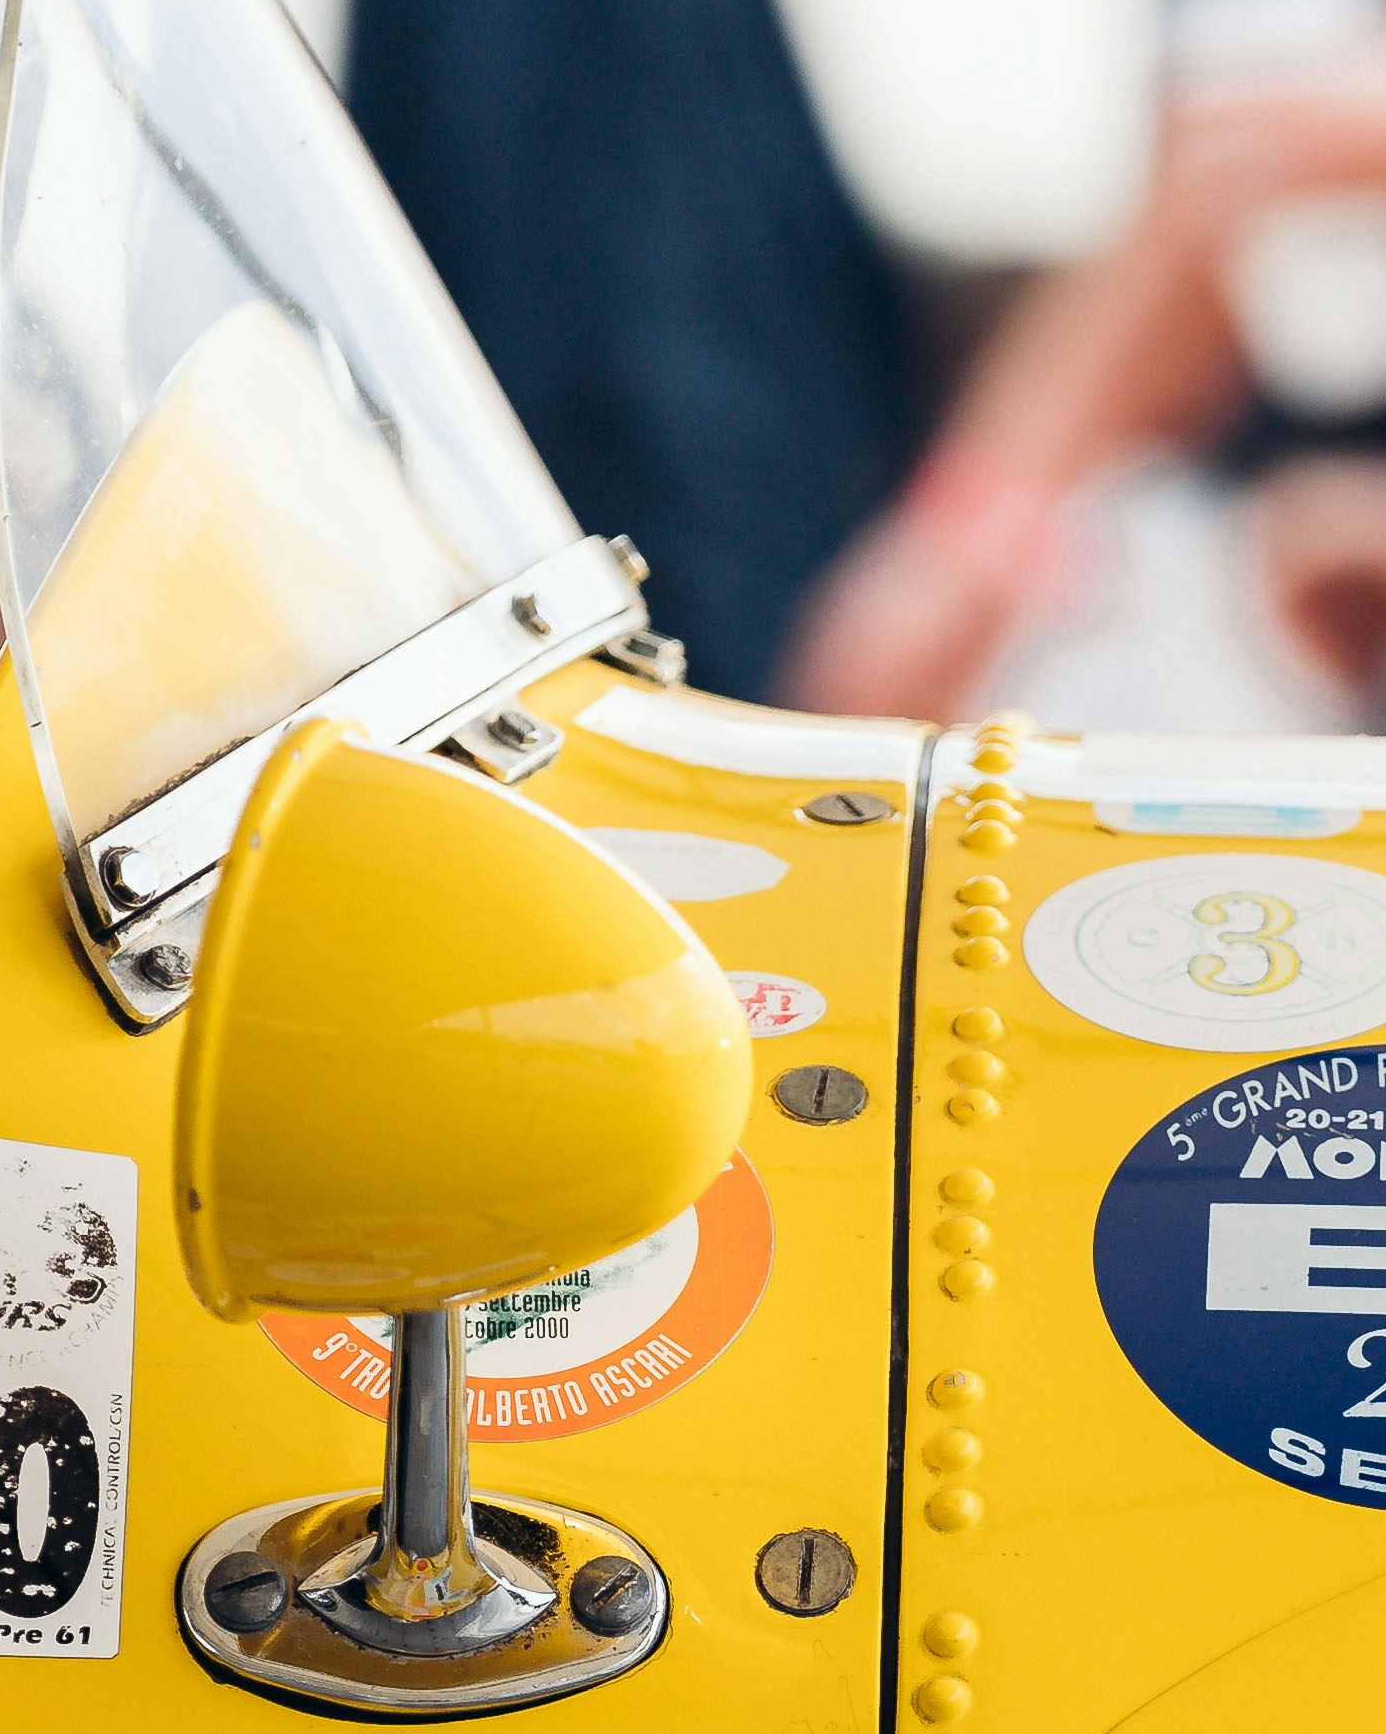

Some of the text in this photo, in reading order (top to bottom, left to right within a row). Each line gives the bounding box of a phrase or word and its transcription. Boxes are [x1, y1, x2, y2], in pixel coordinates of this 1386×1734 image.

[1188, 892, 1302, 996] 3
[1211, 1055, 1358, 1130] GRAND
[1284, 1108, 1385, 1132] 20-21
[464, 1317, 569, 1340] tobre 2000
[339, 1349, 391, 1401] TRO
[589, 1333, 694, 1407] ASCARI
[55, 1626, 91, 1645] 61
